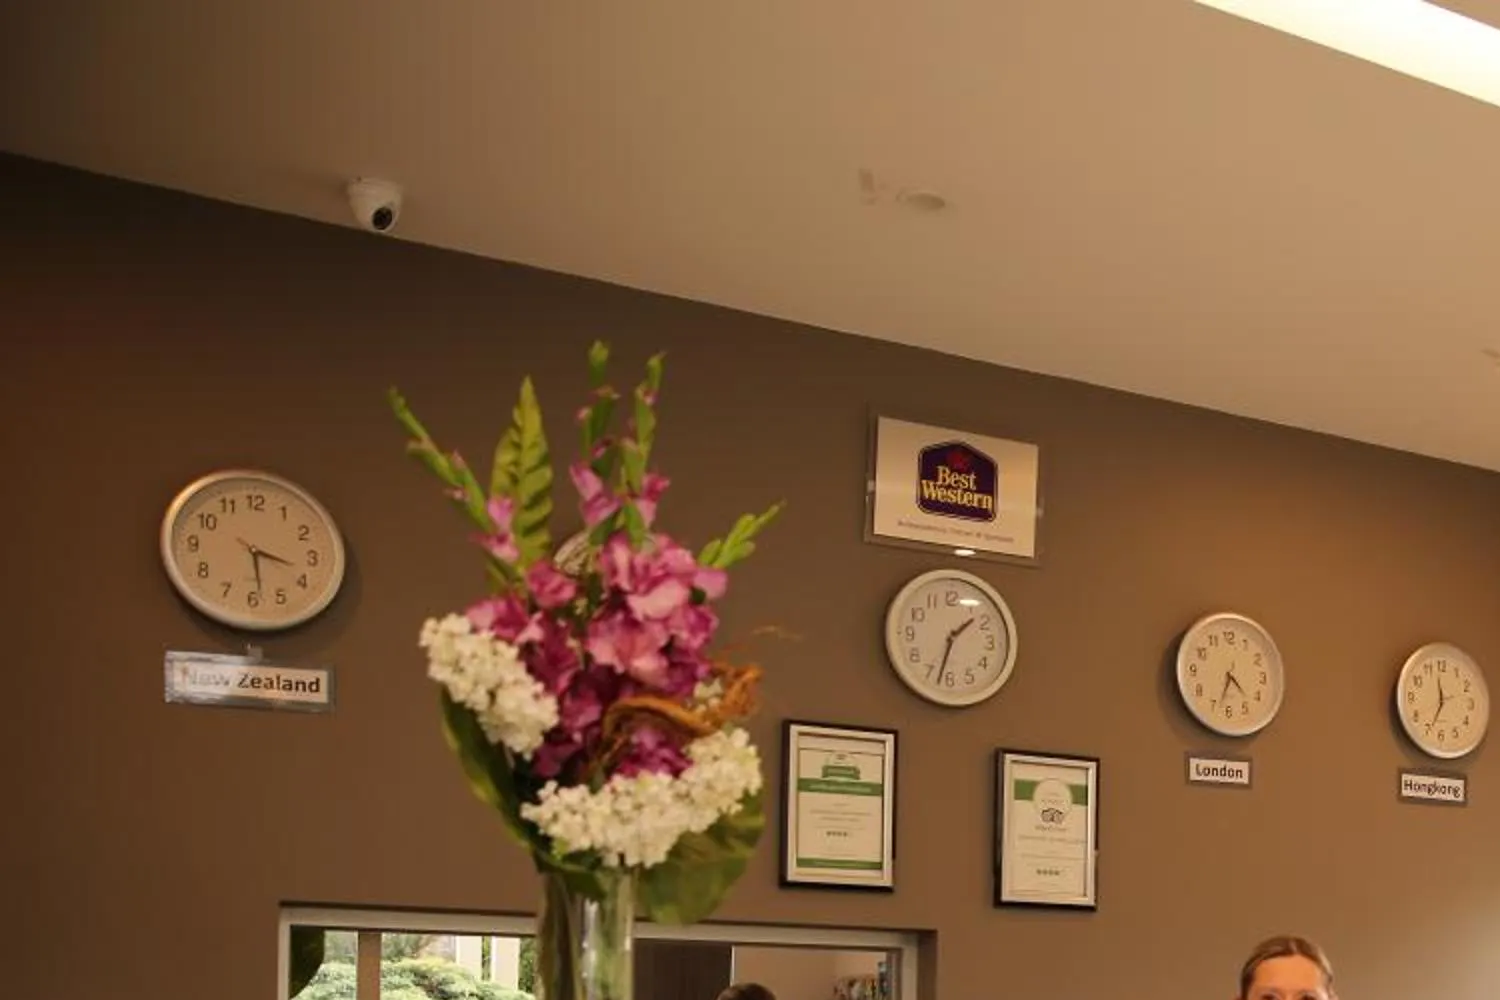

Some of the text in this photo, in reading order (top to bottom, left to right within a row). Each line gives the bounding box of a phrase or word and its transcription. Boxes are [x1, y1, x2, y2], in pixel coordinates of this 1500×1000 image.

[937, 465, 977, 490] Best
[921, 479, 993, 509] Western
[219, 498, 236, 514] 11
[247, 495, 265, 512] 12
[281, 506, 287, 521] 1
[198, 514, 218, 530] 10
[298, 525, 310, 541] 2
[187, 535, 199, 551] 9
[307, 550, 318, 566] 3
[198, 562, 209, 578] 8
[297, 574, 308, 589] 4
[222, 583, 231, 598] 7
[276, 589, 287, 604] 5
[248, 592, 259, 608] 6
[927, 594, 937, 609] 11
[946, 591, 959, 607] 12
[911, 607, 925, 622] 10
[980, 615, 990, 631] 2
[905, 626, 914, 641] 9
[1223, 632, 1235, 645] 12
[985, 635, 995, 650] 3
[1208, 635, 1219, 648] 11
[1242, 640, 1248, 652] 1
[910, 648, 920, 663] 8
[1197, 647, 1207, 661] 10
[1254, 653, 1262, 667] 2
[978, 656, 987, 670] 4
[1189, 664, 1197, 676] 9
[1424, 664, 1432, 676] 11
[1437, 660, 1446, 673] 12
[926, 664, 934, 679] 7
[965, 669, 974, 685] 5
[1259, 672, 1267, 685] 3
[1455, 667, 1459, 678] 1
[237, 672, 320, 693] Zealand
[946, 672, 955, 687] 6
[1413, 676, 1422, 688] 10
[1464, 680, 1470, 692] 2
[1196, 684, 1203, 696] 8
[1255, 691, 1261, 702] 4
[1408, 692, 1414, 703] 9
[1210, 700, 1216, 711] 7
[1225, 706, 1233, 719] 6
[1242, 702, 1249, 714] 5
[1463, 715, 1469, 726] 4
[1425, 724, 1432, 736] 7
[1438, 730, 1445, 742] 6
[1452, 727, 1459, 738] 5
[1196, 764, 1243, 779] London
